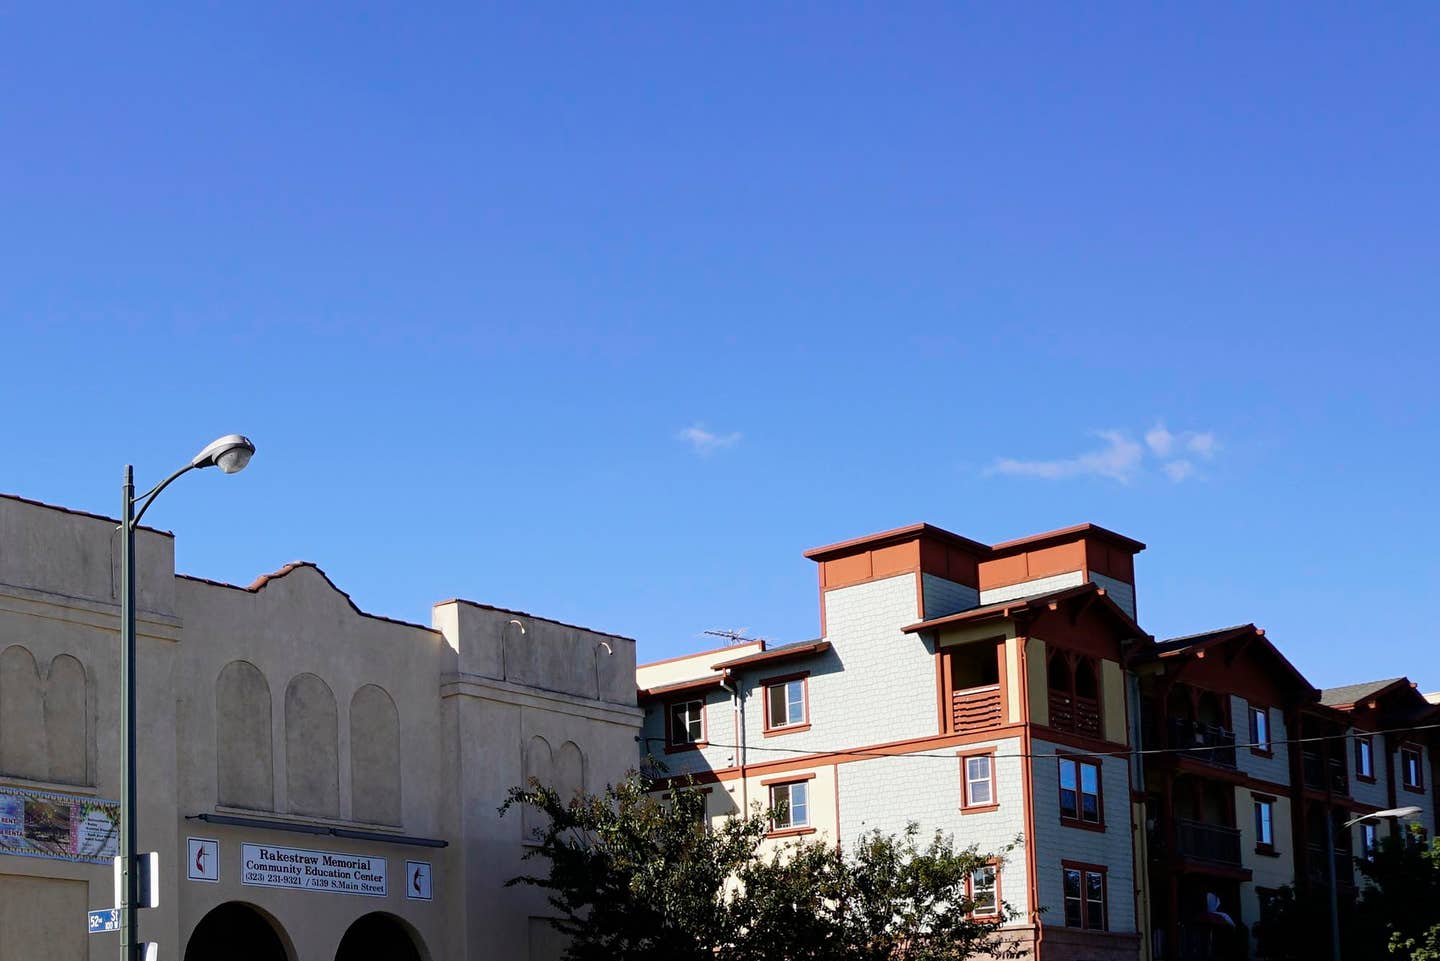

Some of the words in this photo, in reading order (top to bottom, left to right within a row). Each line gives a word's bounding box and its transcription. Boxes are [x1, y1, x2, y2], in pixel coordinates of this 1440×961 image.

[260, 848, 318, 865] Rakestraw
[322, 856, 370, 870] Memorial
[246, 860, 301, 876] Community
[305, 866, 350, 879] Education
[354, 871, 383, 882] Center
[246, 872, 264, 882] (323)
[268, 874, 301, 884] 231-9321
[312, 878, 328, 888] 5139
[361, 883, 384, 892] Street
[110, 910, 118, 921] St
